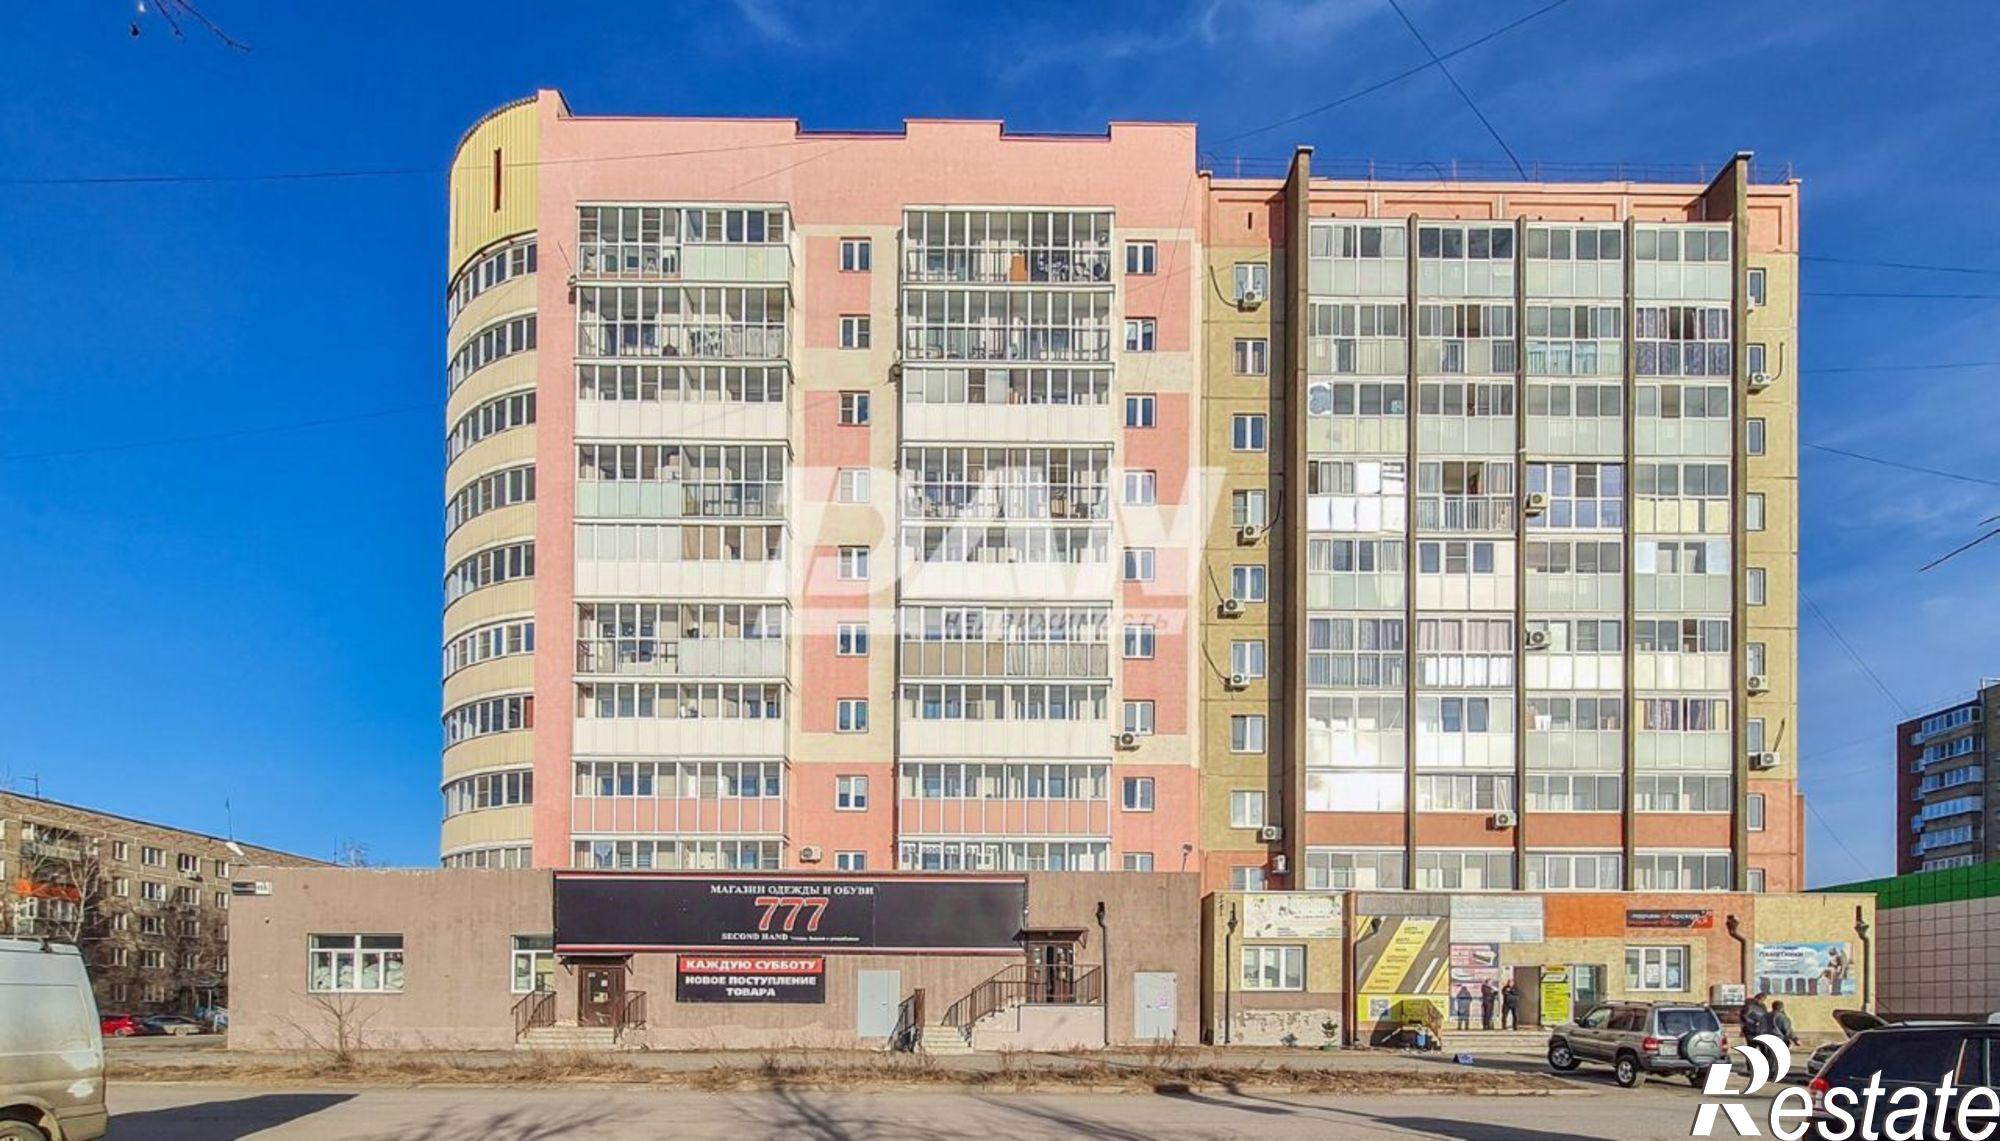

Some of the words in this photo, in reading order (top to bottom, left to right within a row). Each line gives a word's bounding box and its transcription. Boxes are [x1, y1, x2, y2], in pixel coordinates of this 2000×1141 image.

[710, 885, 766, 895] МАГАЗИН
[768, 886, 821, 896] ОДЕЖДЫ
[823, 886, 832, 895] И
[833, 886, 874, 895] ОБУВИ
[754, 896, 829, 931] 777
[721, 932, 760, 941] SECOND
[761, 932, 789, 941] HAND
[686, 960, 752, 971] КАЖДУЮ
[755, 960, 817, 970] СУББОТУ
[685, 976, 727, 985] НОВОЕ
[728, 976, 817, 985] ПОСТУПЛЕНИЕ
[725, 987, 776, 997] ТОВАРА
